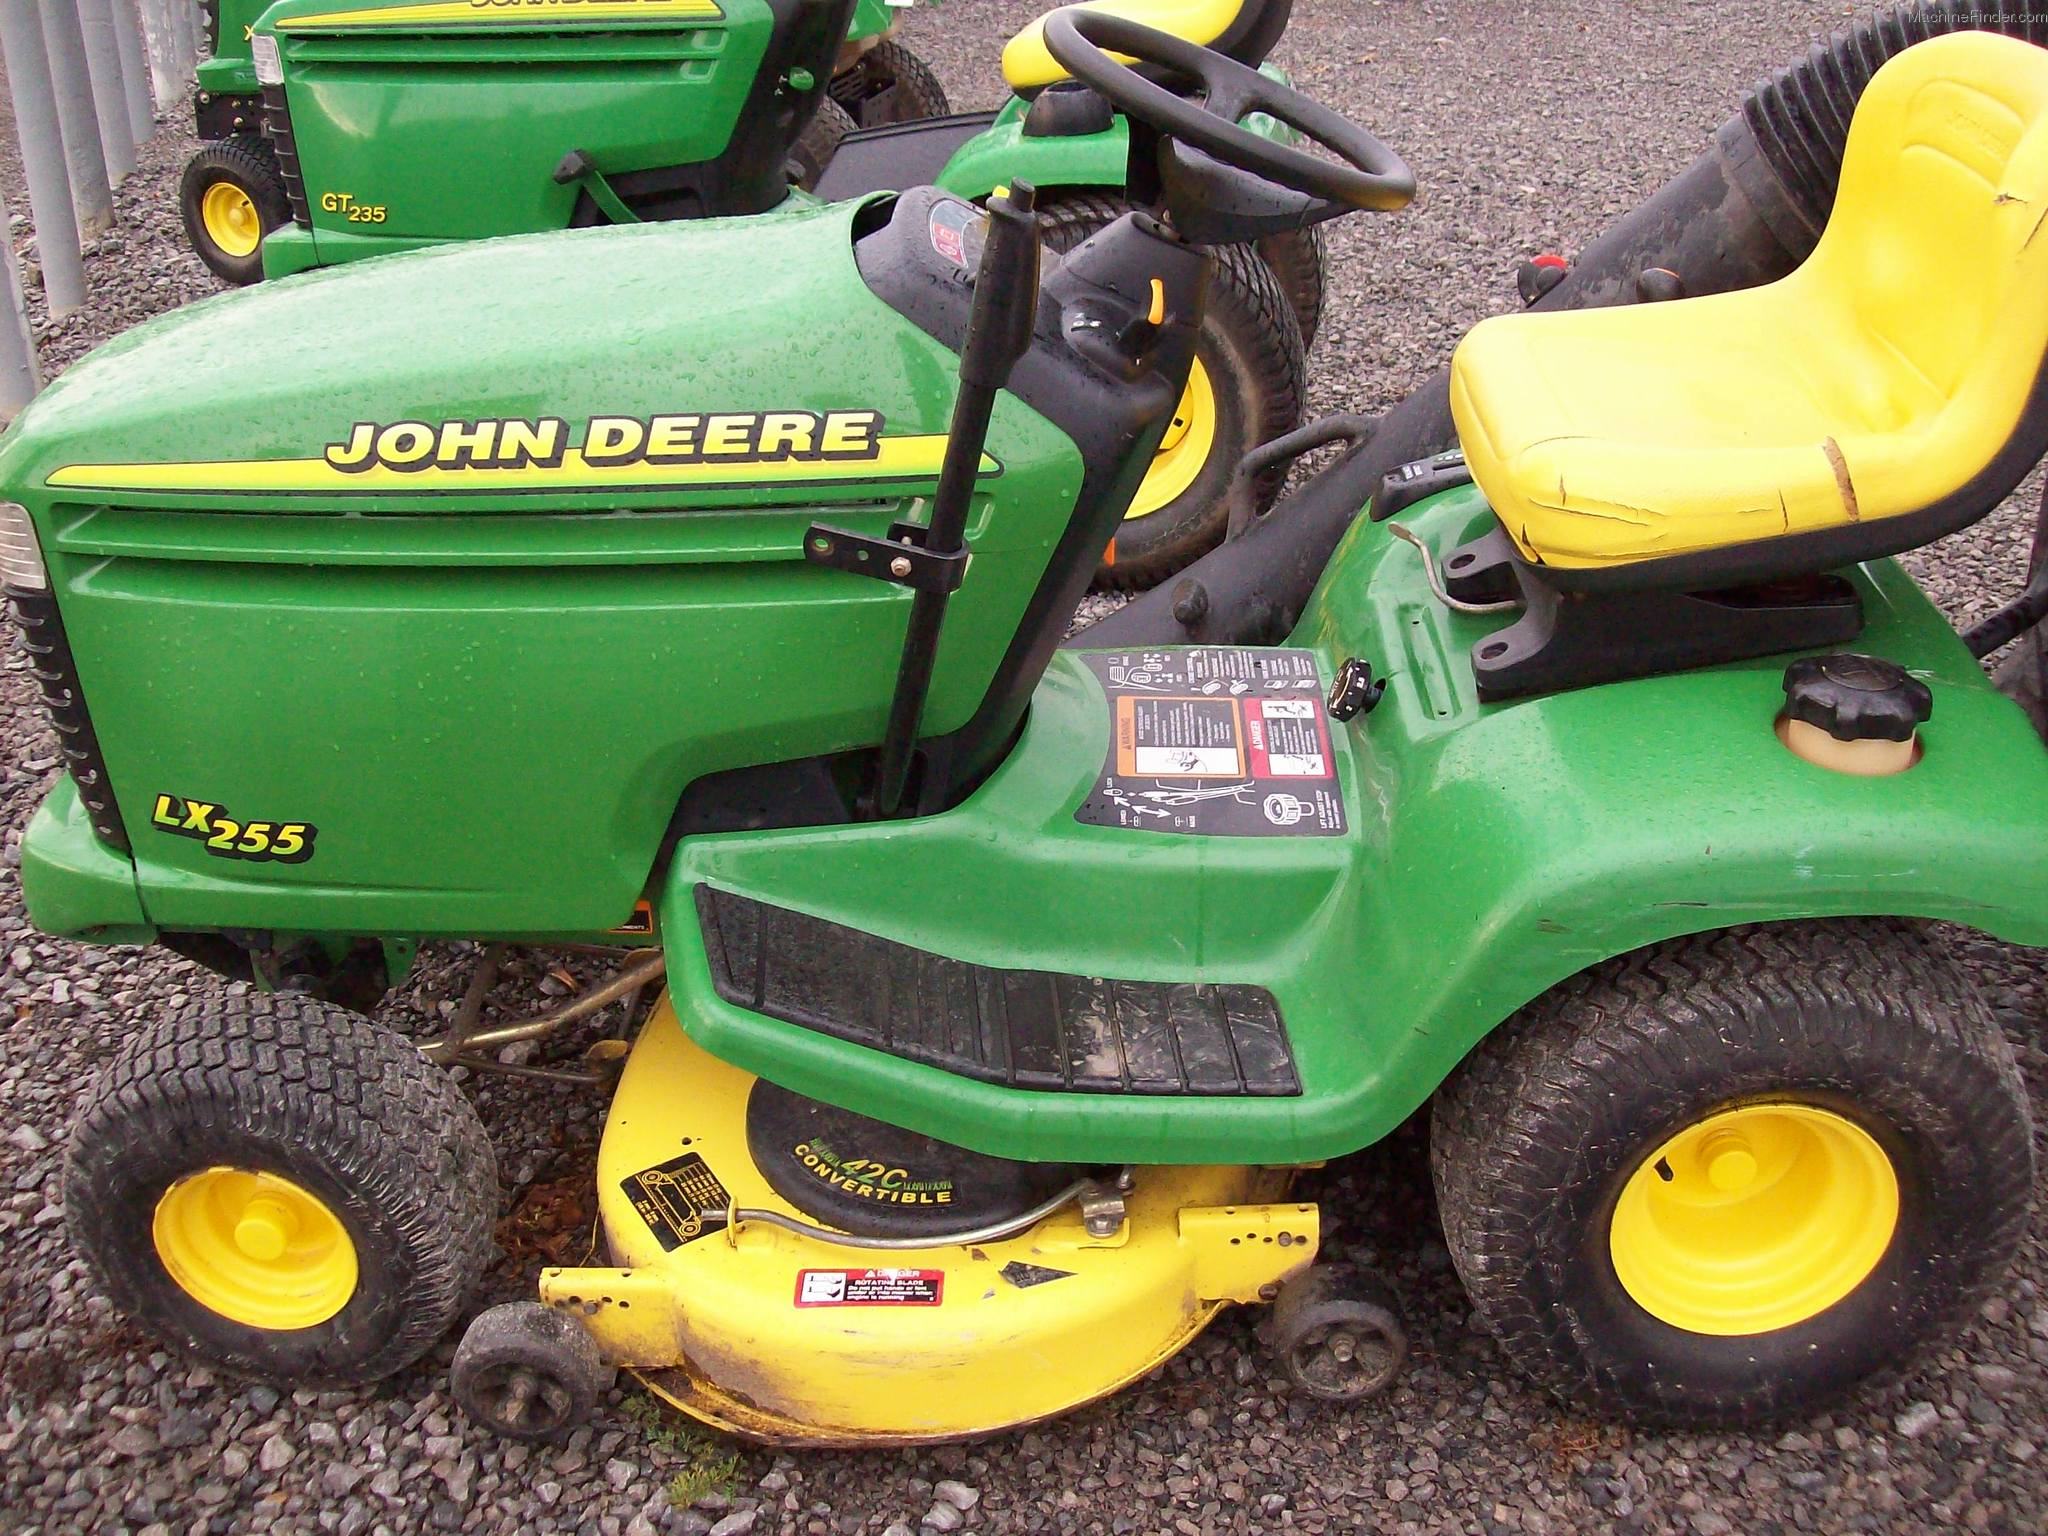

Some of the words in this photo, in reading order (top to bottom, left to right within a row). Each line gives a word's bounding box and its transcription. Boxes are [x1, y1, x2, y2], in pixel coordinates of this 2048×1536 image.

[325, 418, 570, 474] JOHN
[582, 409, 885, 467] DEERE
[794, 1144, 952, 1204] CONVERTIBLE
[841, 1159, 908, 1189] 42C
